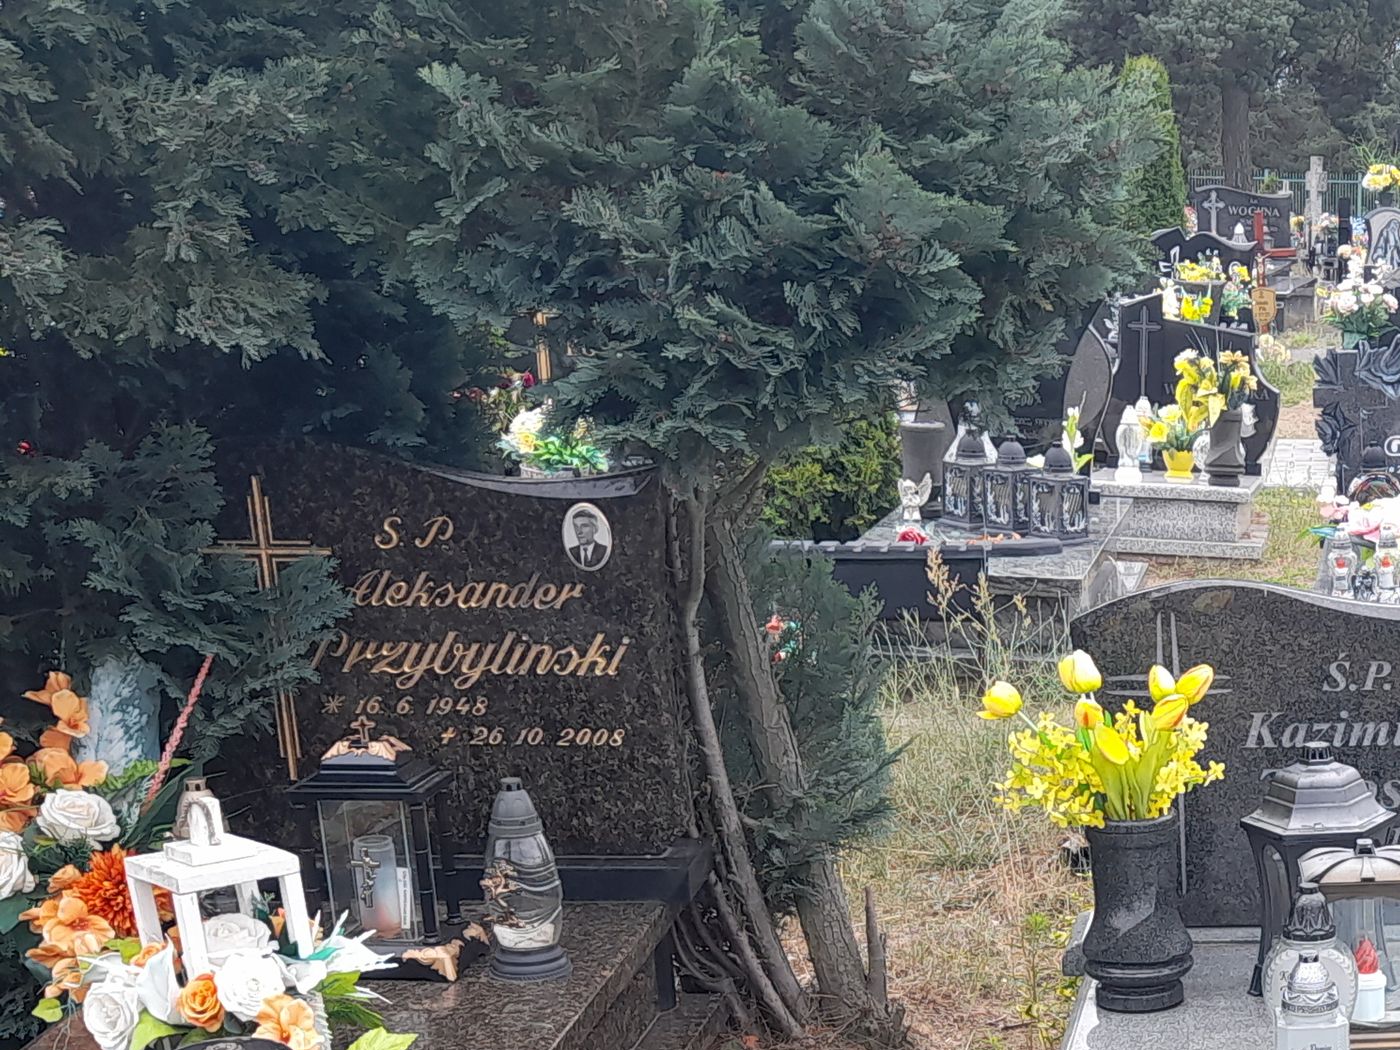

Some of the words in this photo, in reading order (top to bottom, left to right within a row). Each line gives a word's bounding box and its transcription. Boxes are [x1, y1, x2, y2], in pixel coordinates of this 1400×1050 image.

[346, 568, 587, 611] Aleksander
[1322, 652, 1393, 692] Ś.P.
[425, 697, 489, 716] 1948
[556, 728, 626, 747] 2008
